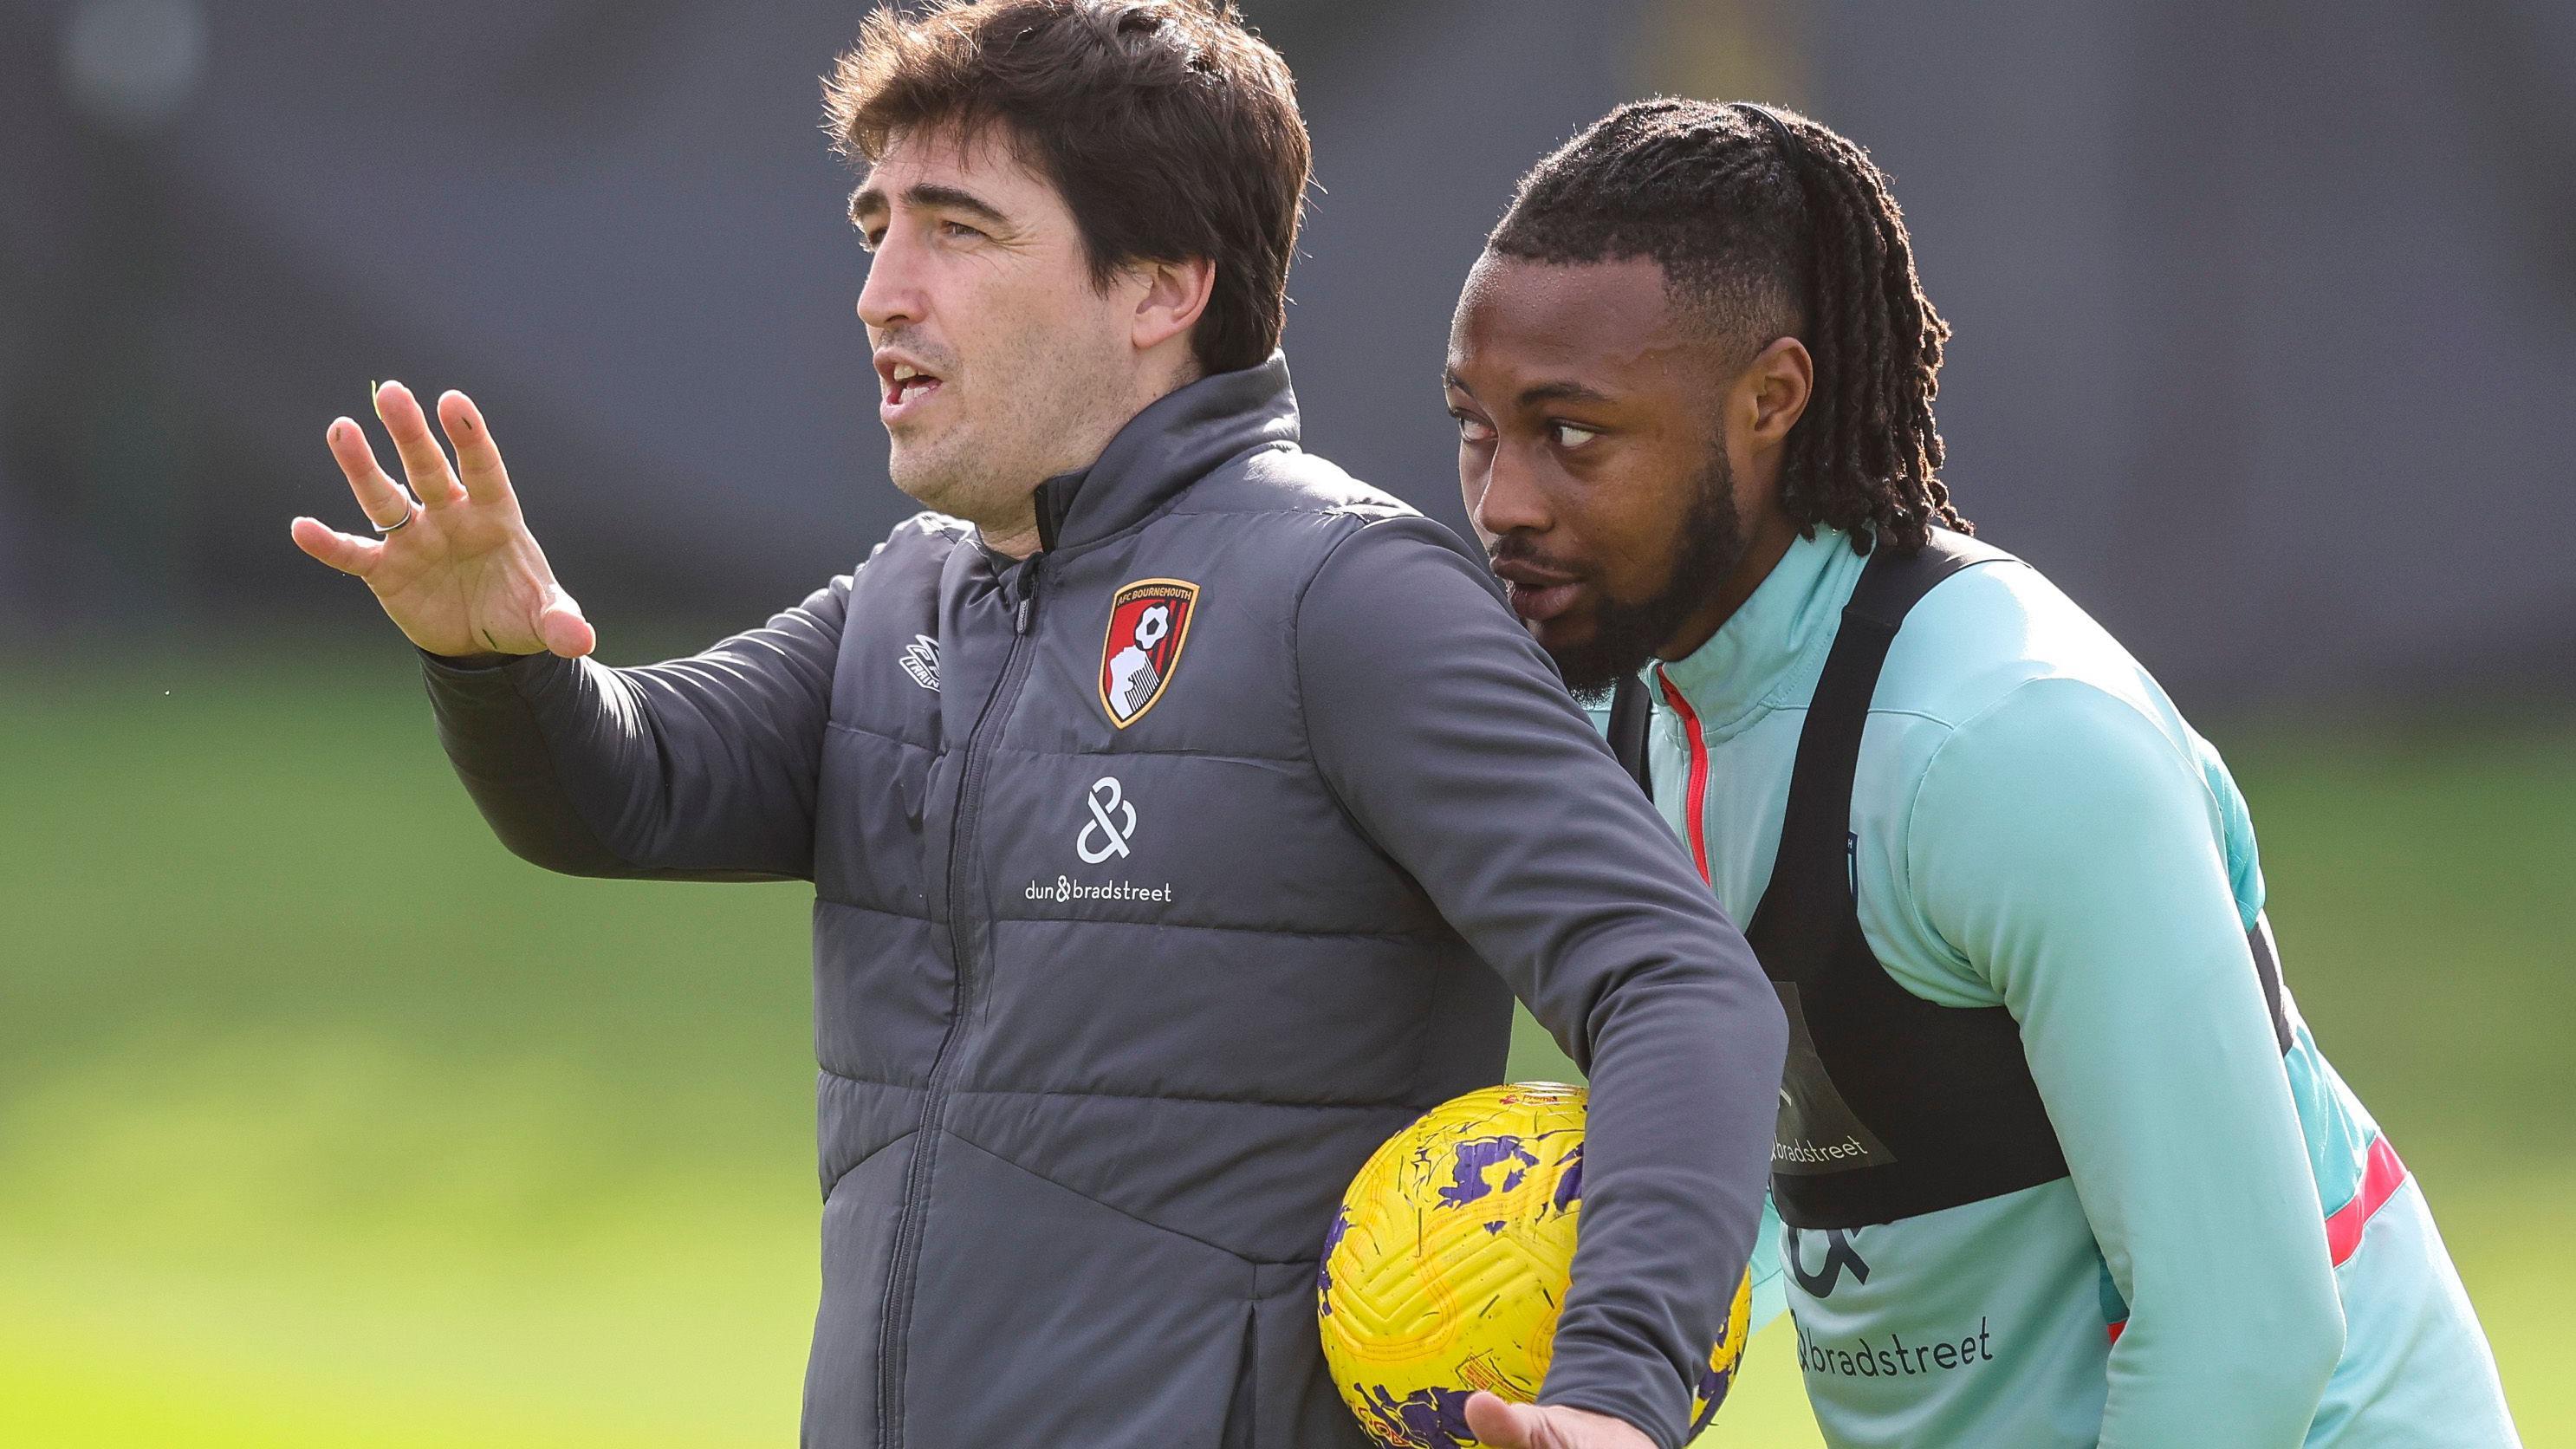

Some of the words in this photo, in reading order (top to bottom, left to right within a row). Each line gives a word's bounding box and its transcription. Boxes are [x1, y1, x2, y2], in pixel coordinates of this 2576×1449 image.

[1118, 593, 1132, 606] AFC
[1132, 587, 1192, 601] BOURNEMOUTH
[1025, 874, 1171, 903] dun&bradstreet
